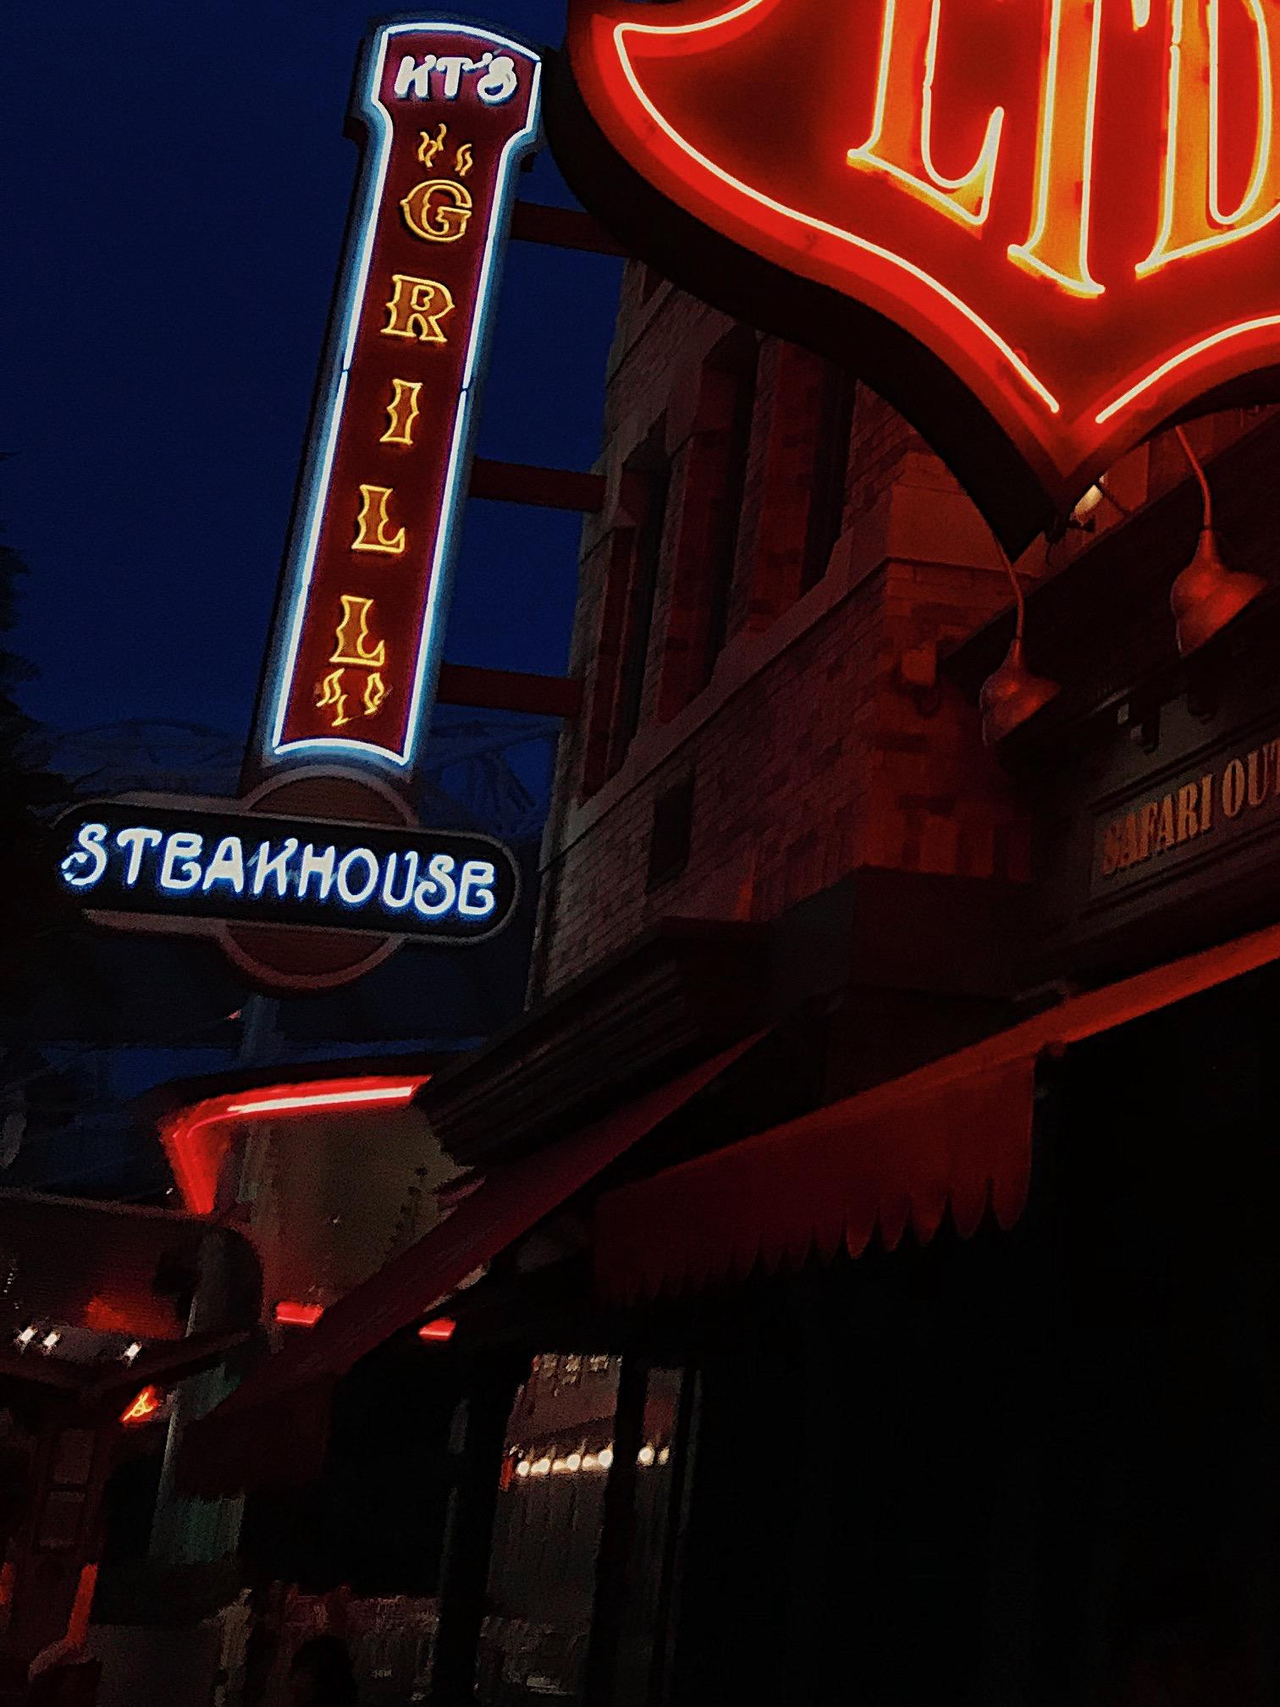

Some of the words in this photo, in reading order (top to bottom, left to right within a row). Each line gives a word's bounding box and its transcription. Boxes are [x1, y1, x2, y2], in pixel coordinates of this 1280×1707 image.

[328, 179, 473, 667] GRILL
[61, 823, 496, 916] STEAKHOUSE
[1102, 773, 1216, 876] SAFARI
